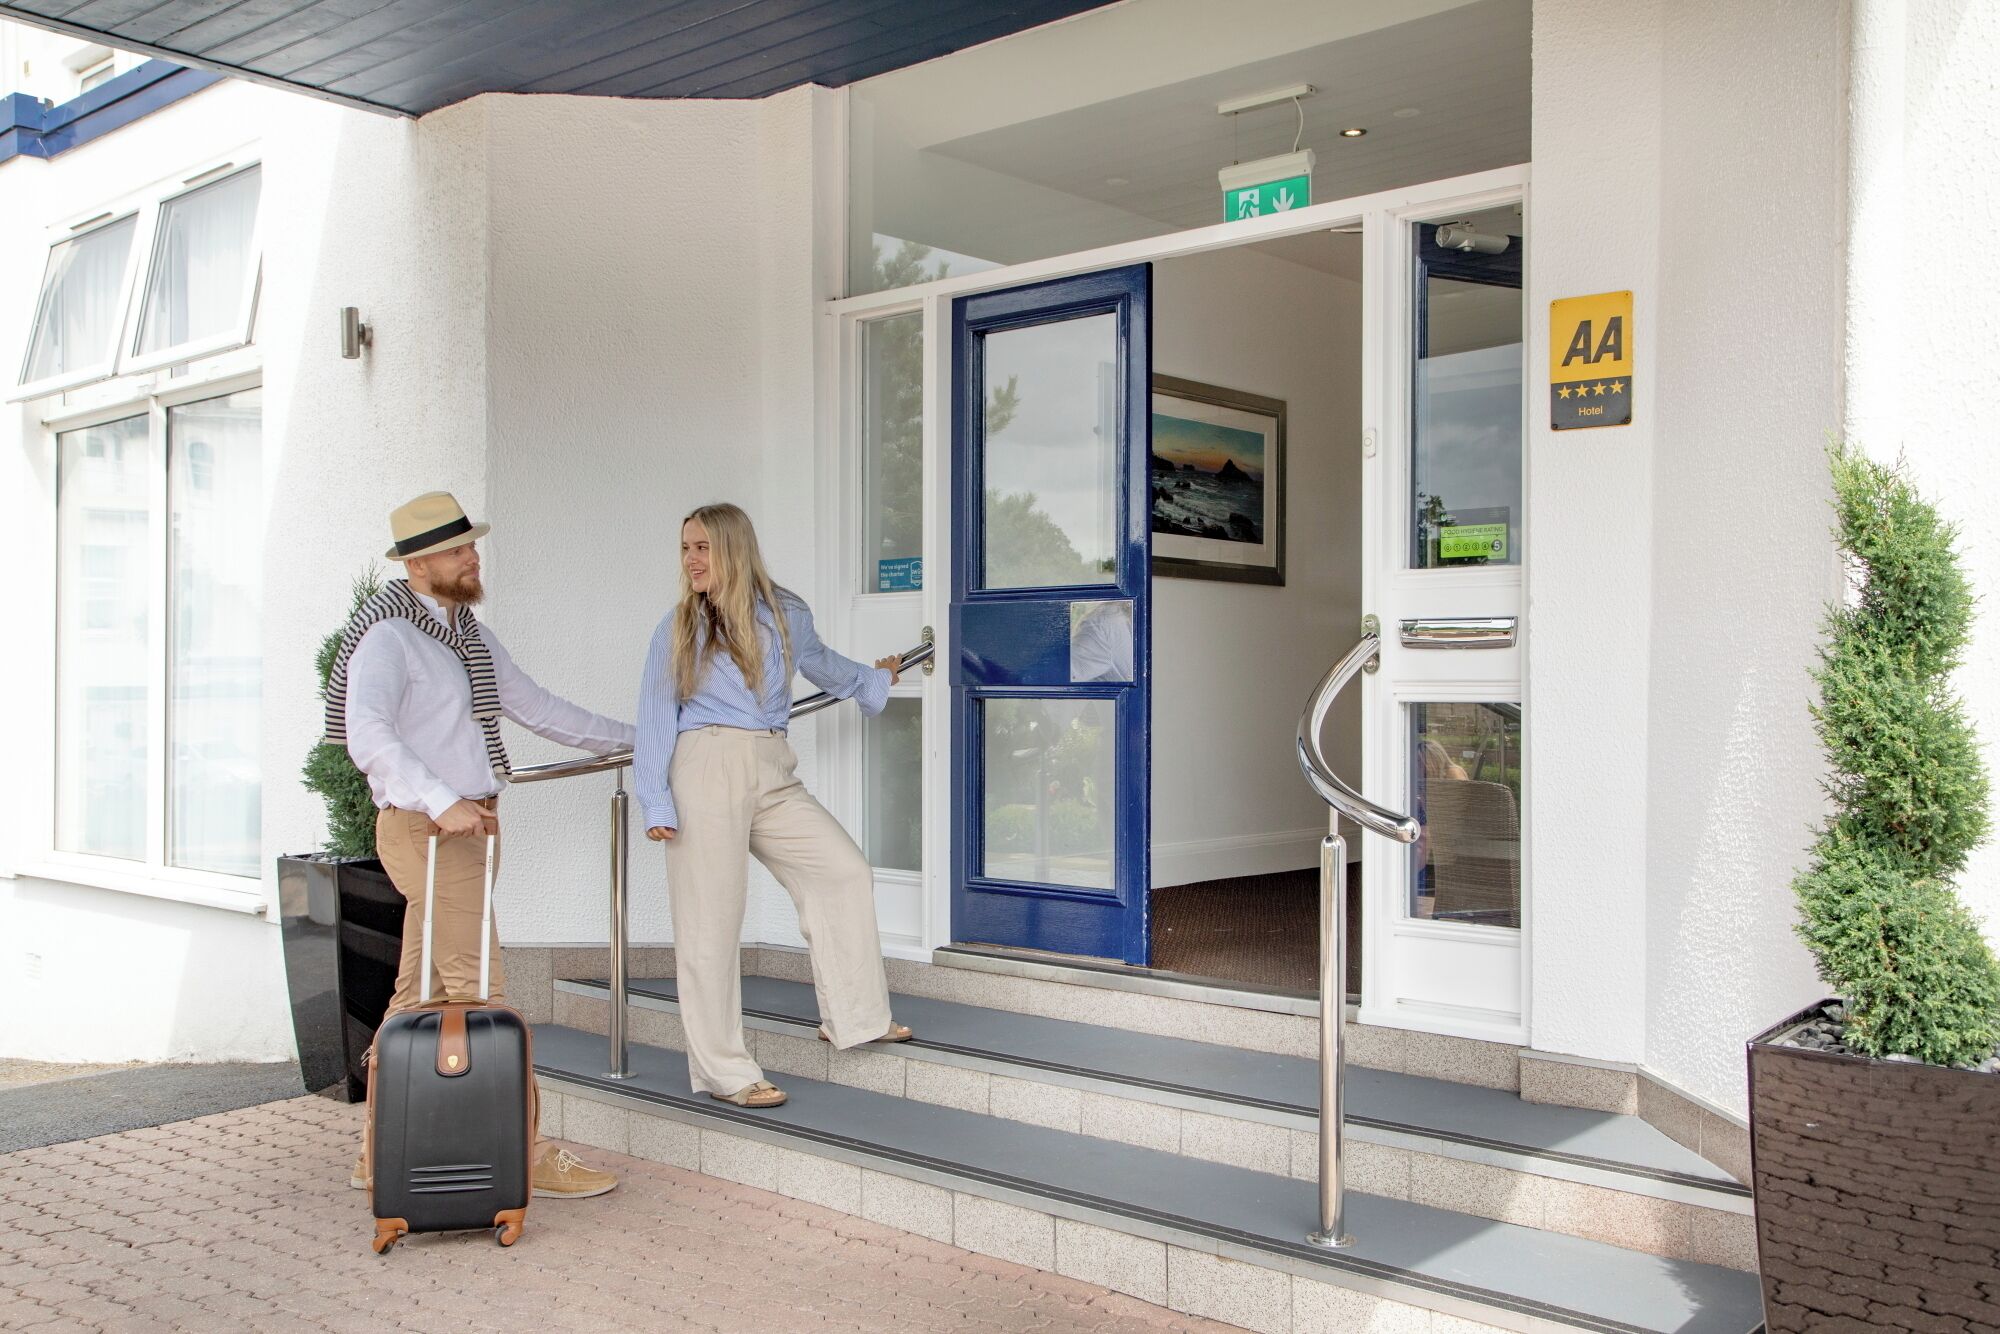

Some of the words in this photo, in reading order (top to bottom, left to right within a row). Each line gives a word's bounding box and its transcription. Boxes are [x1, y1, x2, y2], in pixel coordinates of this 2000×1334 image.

[1561, 316, 1622, 367] AA
[1578, 405, 1603, 417] Hotel
[894, 563, 909, 571] signed
